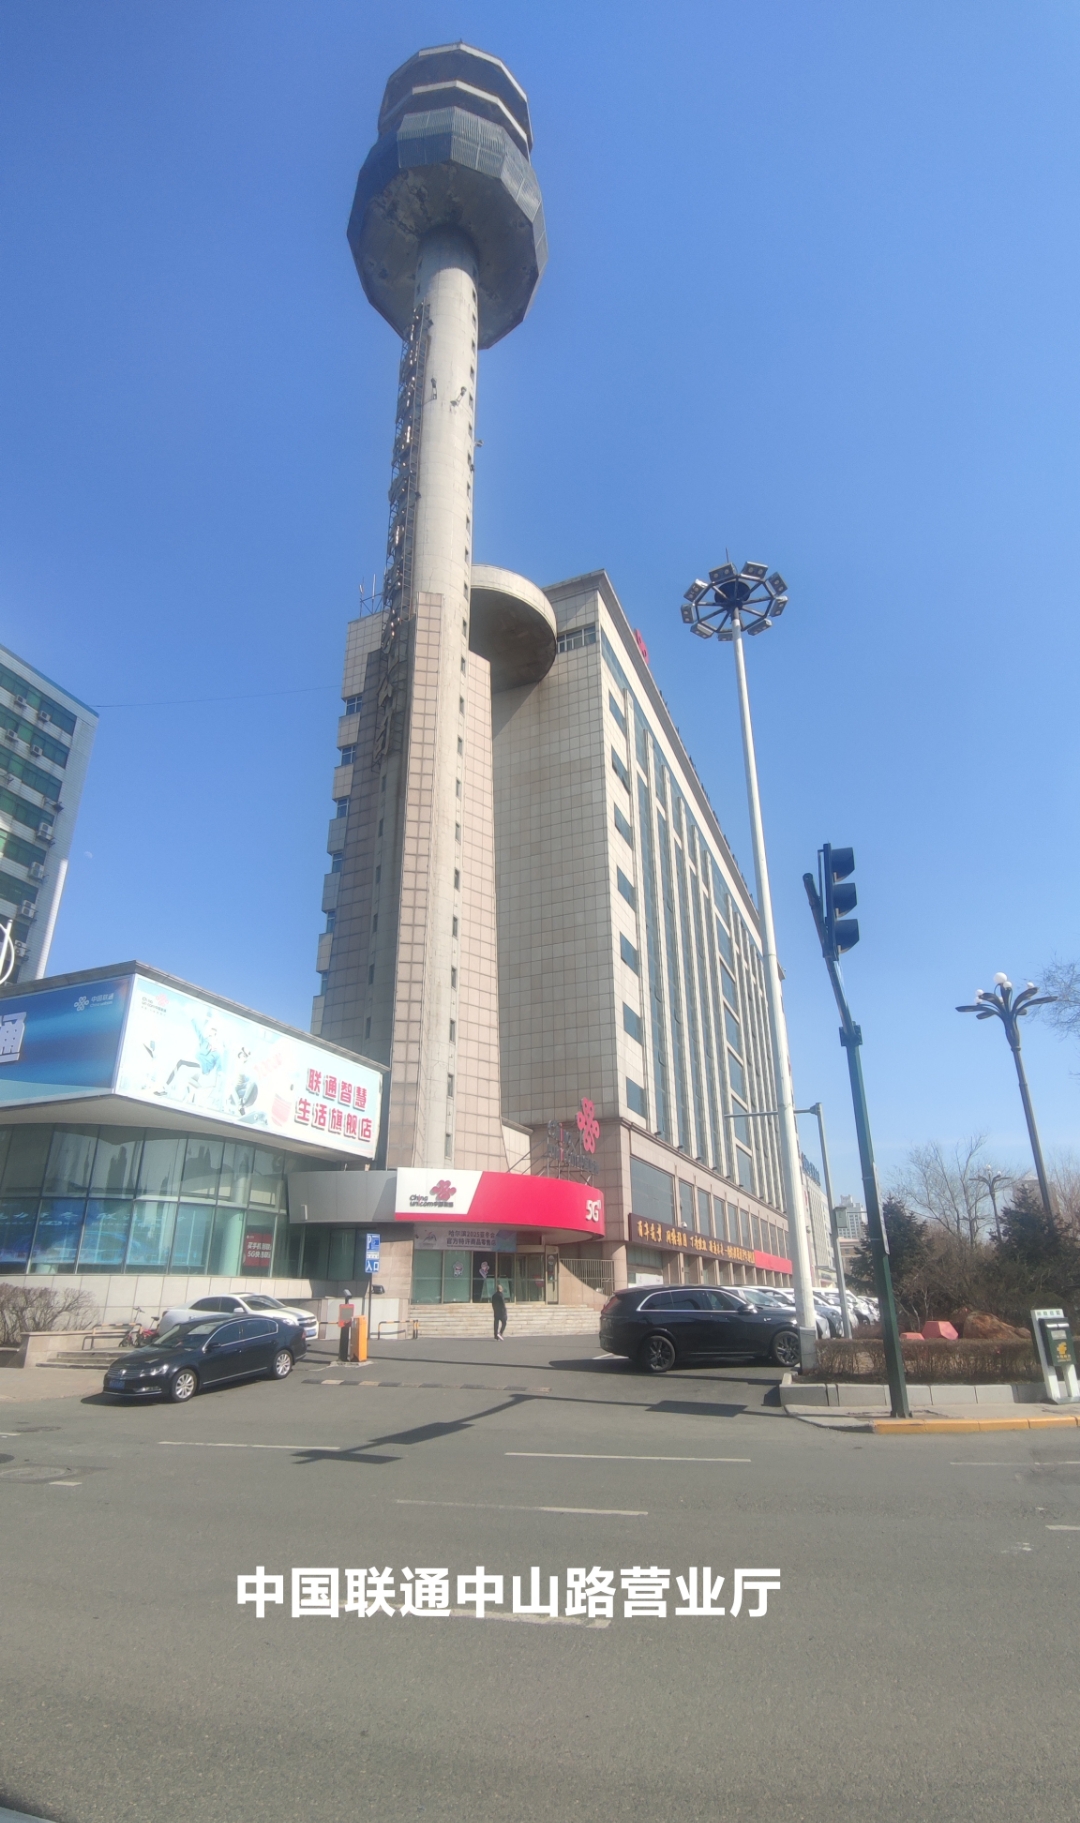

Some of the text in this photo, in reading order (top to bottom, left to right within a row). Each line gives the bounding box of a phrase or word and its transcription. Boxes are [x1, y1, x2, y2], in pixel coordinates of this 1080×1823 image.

[307, 1068, 368, 1110] 联通智慧
[295, 1097, 373, 1140] 生活旗舰店
[448, 1229, 495, 1239] 哈尔滨2025亚冬会
[367, 1236, 372, 1249] P
[365, 1261, 379, 1272] 入口
